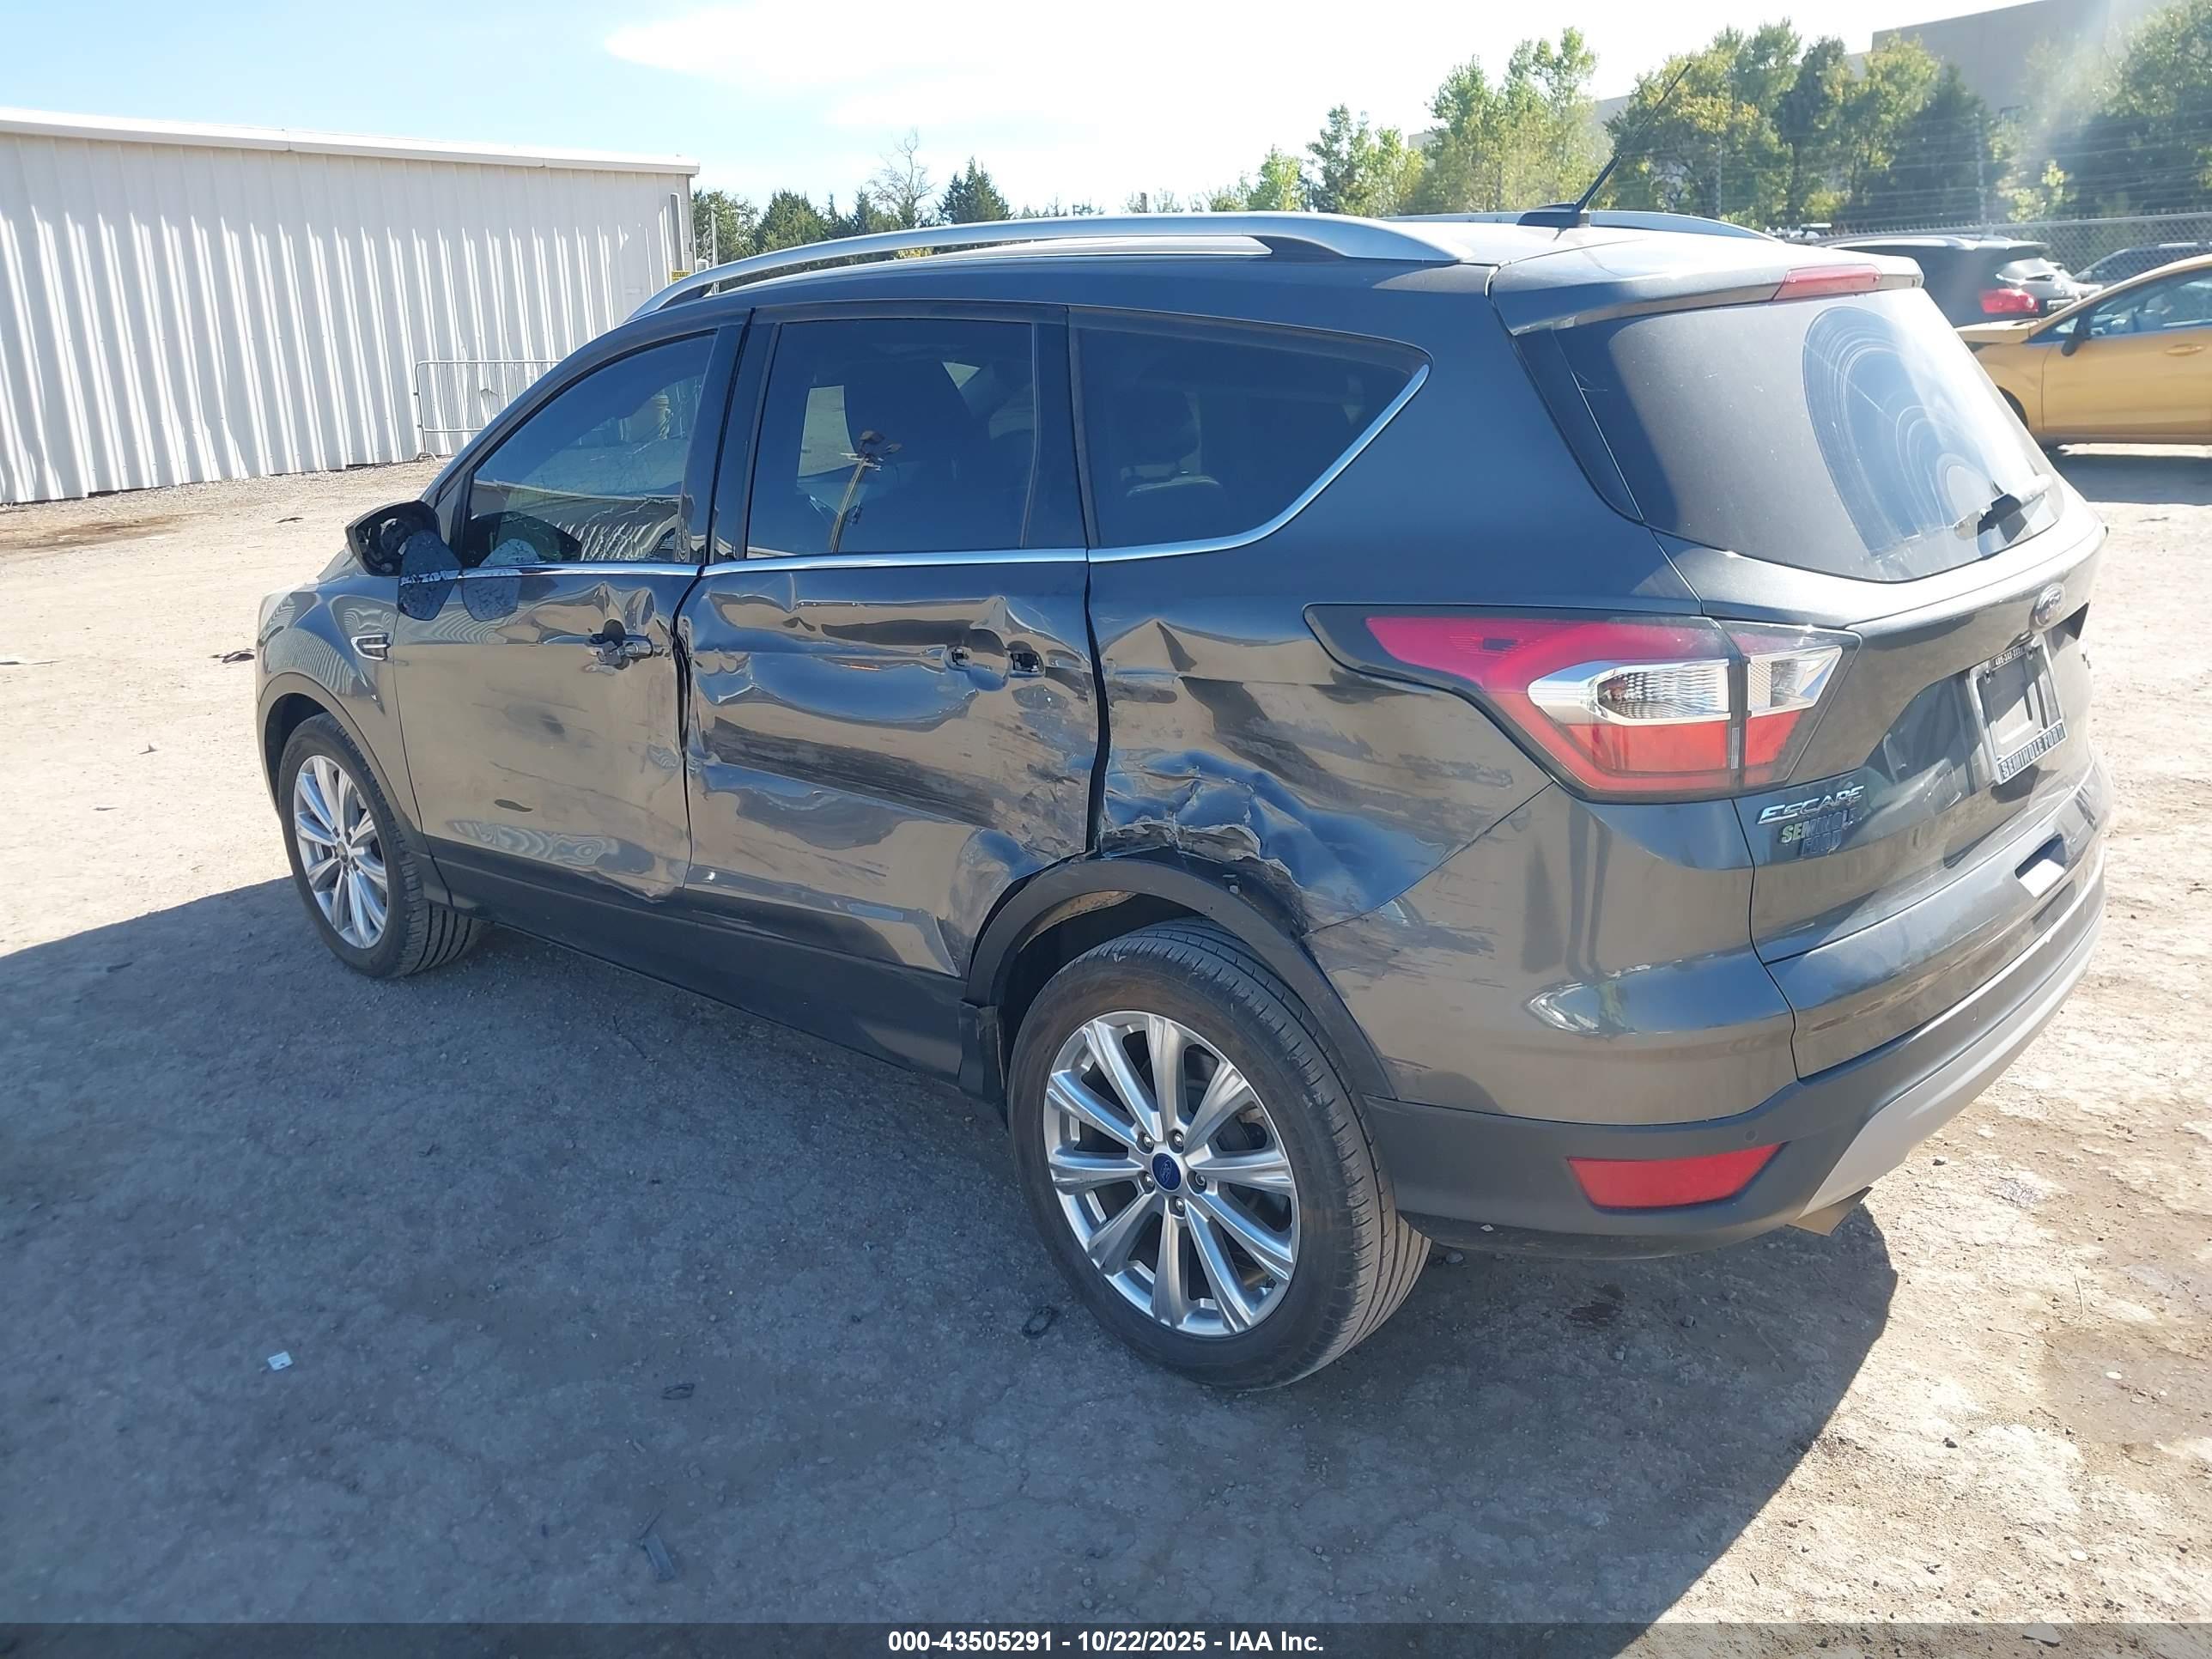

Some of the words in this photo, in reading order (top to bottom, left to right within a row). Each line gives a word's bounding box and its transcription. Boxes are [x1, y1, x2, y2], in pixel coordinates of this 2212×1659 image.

[2001, 738, 2044, 778] SEMINOLE
[2043, 724, 2066, 750] FORD
[1757, 785, 1864, 824] ESCAPE
